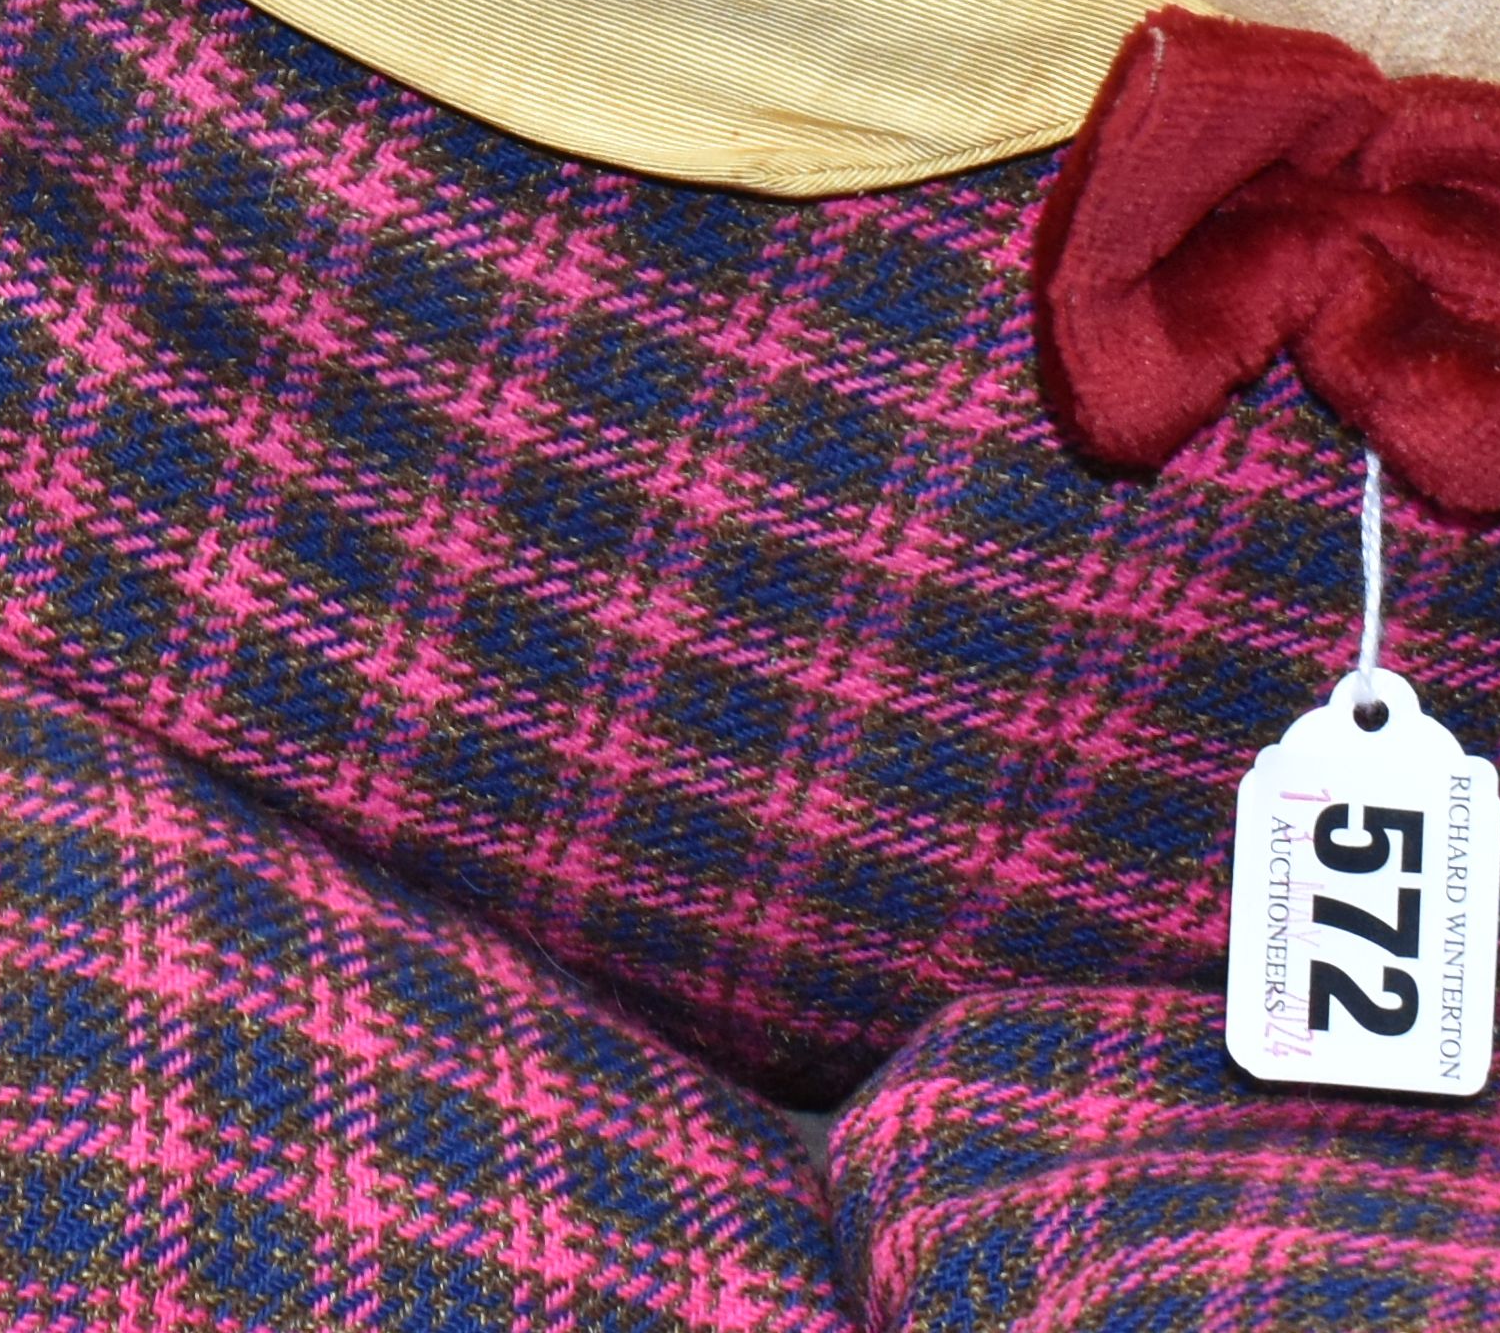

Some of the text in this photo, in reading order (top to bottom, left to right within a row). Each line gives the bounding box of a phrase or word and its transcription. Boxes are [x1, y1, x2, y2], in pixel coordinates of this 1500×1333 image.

[1264, 815, 1293, 1014] AUCTIONEERS
[1308, 803, 1424, 1037] 572
[1440, 774, 1472, 1080] RICHARD WINTERTON
